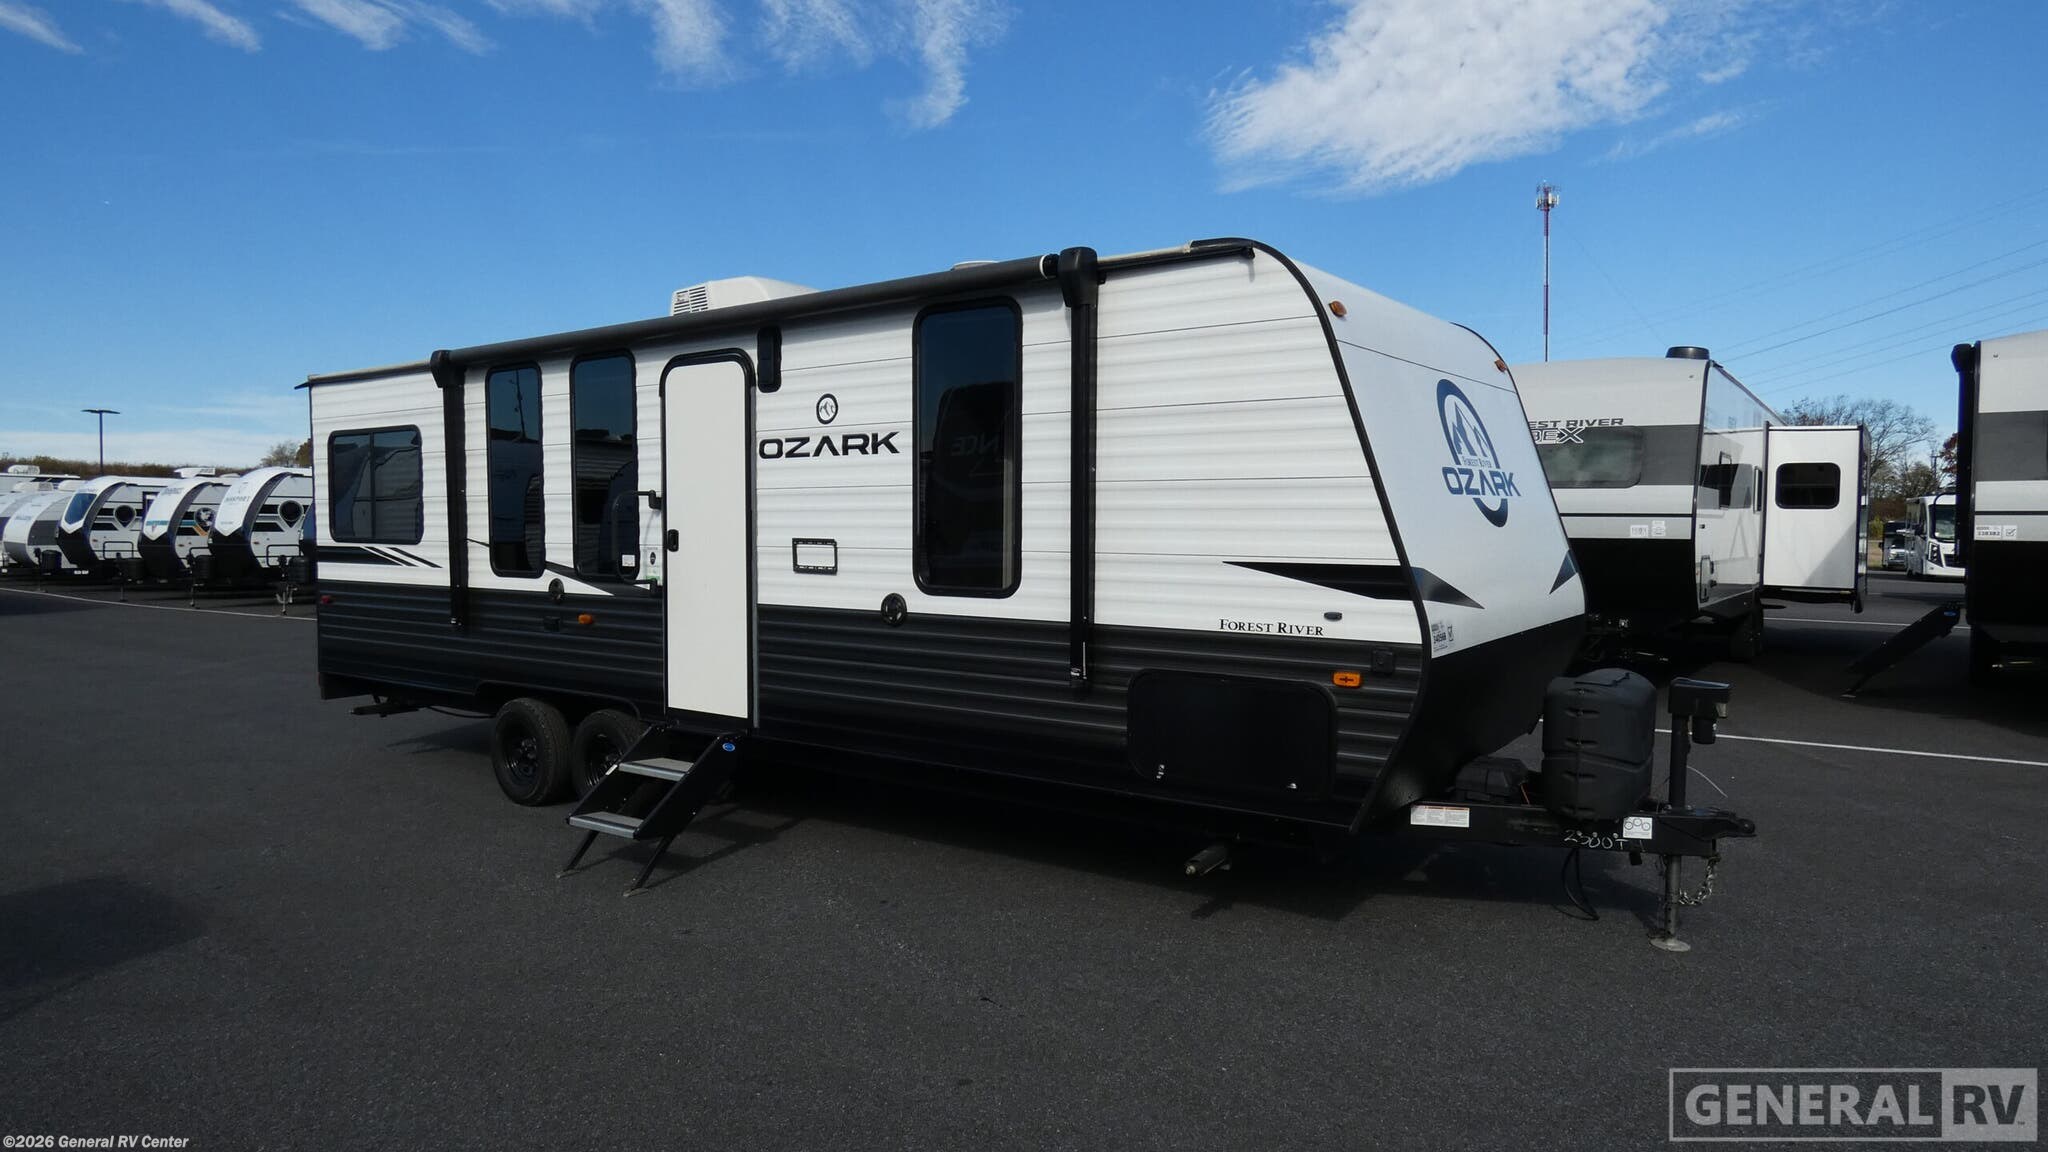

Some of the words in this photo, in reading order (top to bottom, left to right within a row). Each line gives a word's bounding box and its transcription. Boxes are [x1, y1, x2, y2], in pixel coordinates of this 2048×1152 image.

[1566, 418, 1624, 428] RIVER
[759, 431, 900, 459] OZARK
[1442, 467, 1521, 497] OZARK
[1219, 619, 1274, 632] FOREST
[1277, 622, 1324, 636] RIVER
